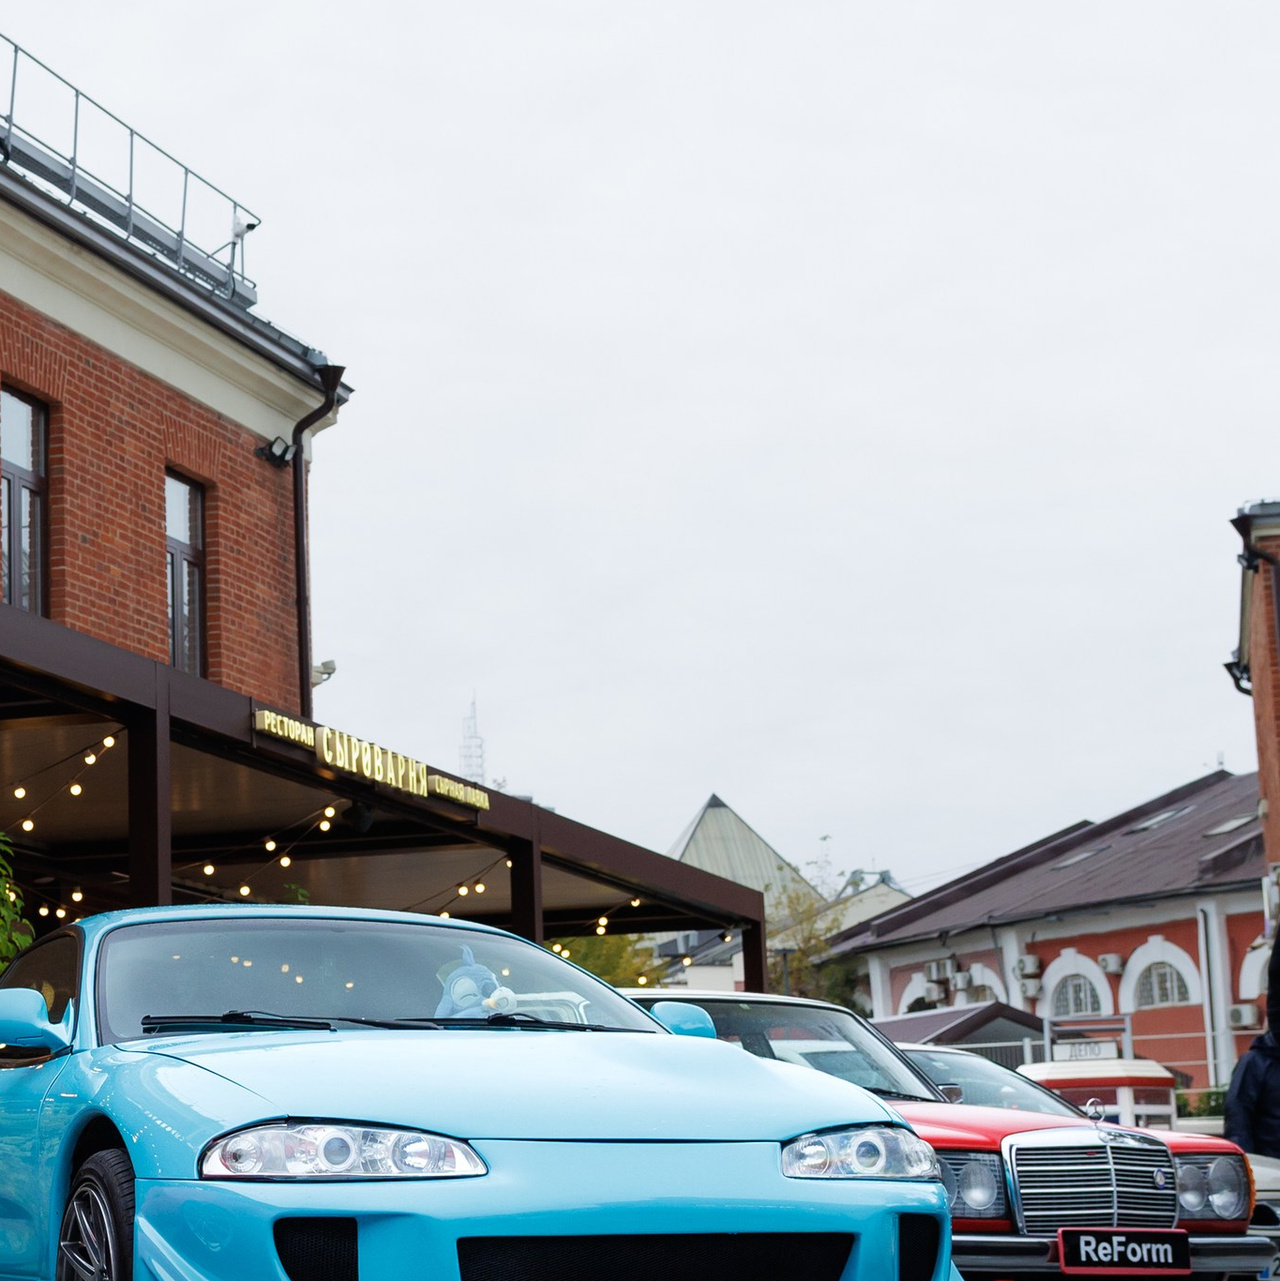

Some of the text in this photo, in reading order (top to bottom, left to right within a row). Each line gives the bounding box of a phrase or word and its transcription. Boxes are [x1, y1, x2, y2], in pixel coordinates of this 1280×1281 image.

[261, 709, 315, 747] РЕСТОРАН
[318, 726, 428, 798] СЫРОВАРНЯ
[1069, 1042, 1102, 1060] ДЕПО
[1079, 1235, 1173, 1263] ReForm
